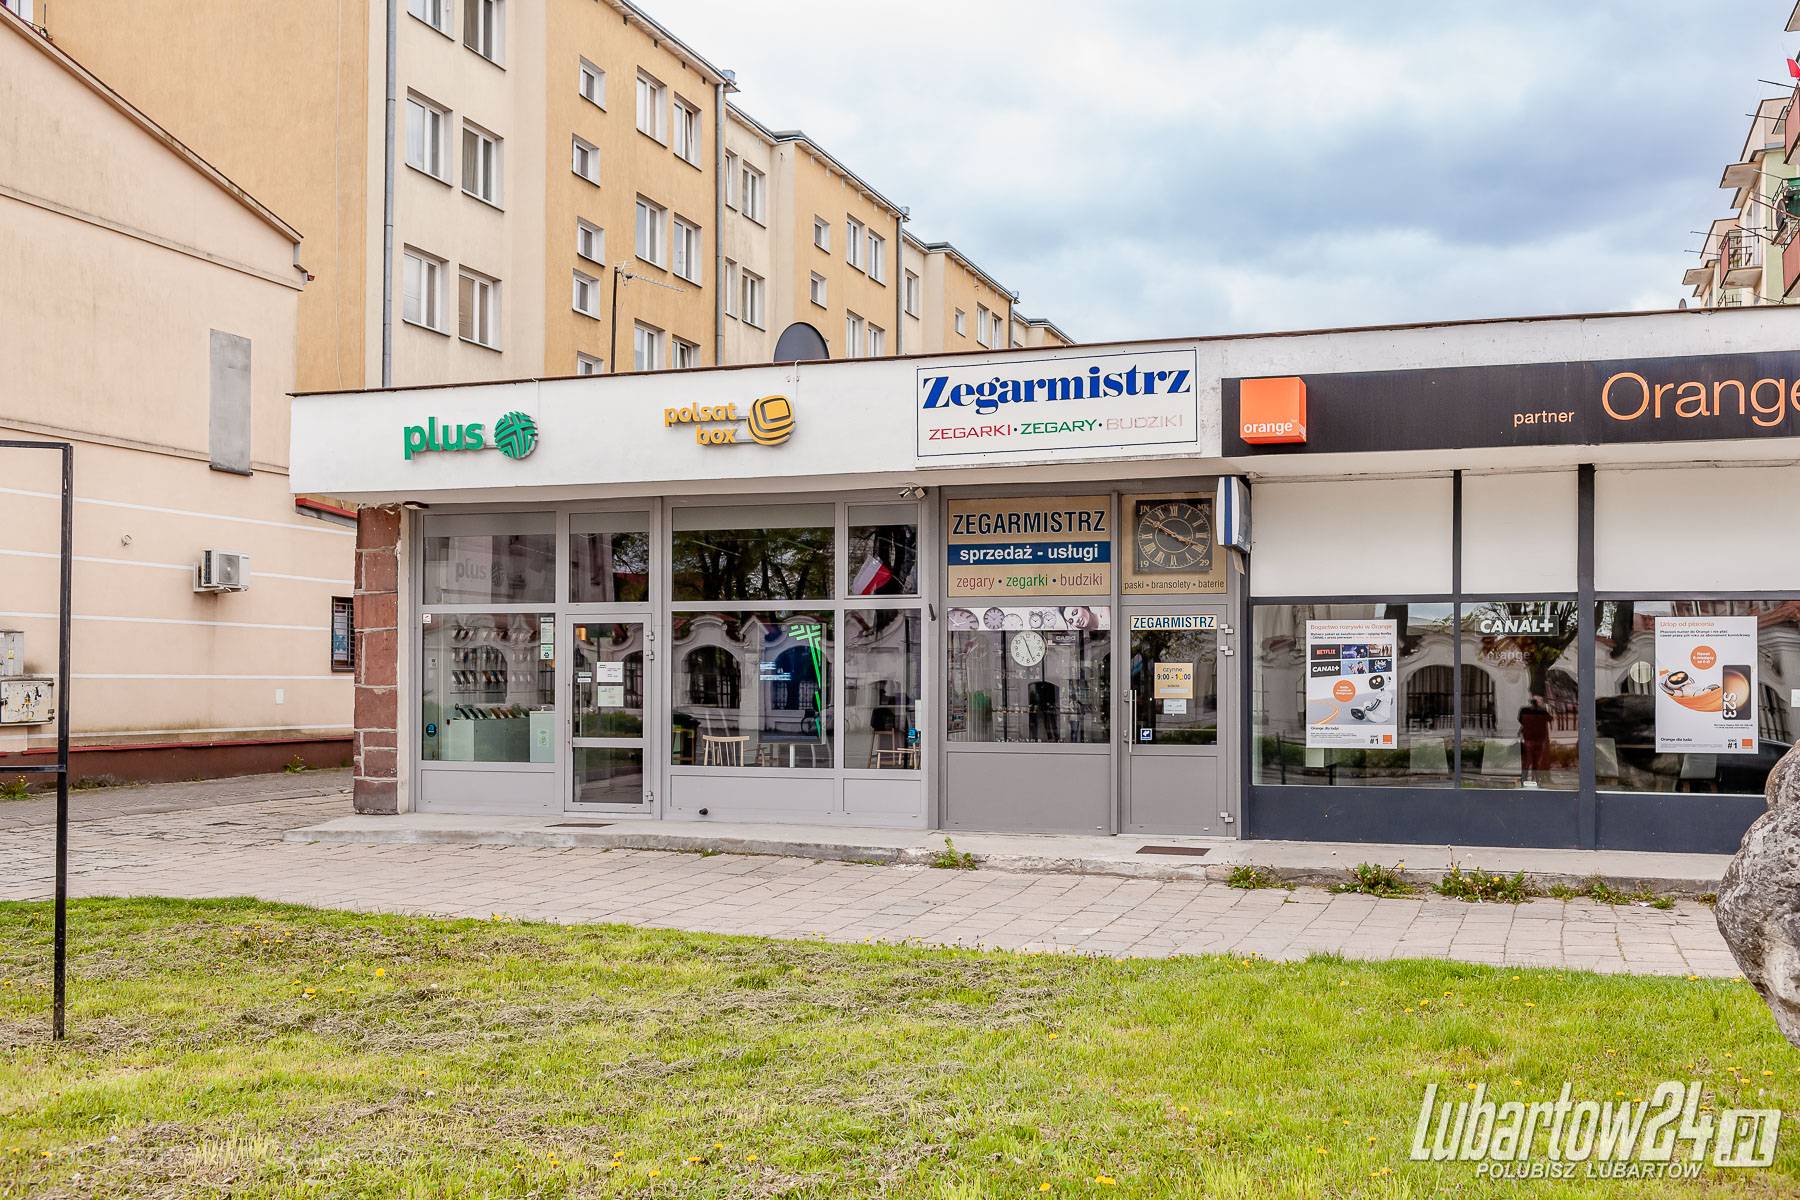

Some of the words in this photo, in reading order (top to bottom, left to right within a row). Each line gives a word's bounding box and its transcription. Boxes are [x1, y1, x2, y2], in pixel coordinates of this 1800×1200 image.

[922, 364, 1191, 415] Zegarmistrz
[1601, 372, 1800, 427] Orang
[664, 402, 737, 427] polsat
[1513, 409, 1575, 426] partner
[696, 424, 737, 446] box
[929, 423, 1011, 440] ZEGARKI
[1021, 418, 1098, 435] ZEGARY
[1106, 414, 1184, 431] BUDZIKI
[1243, 421, 1293, 436] orange
[403, 416, 485, 460] plus
[952, 510, 1106, 535] ZEGARMISTRZ
[960, 545, 1033, 564] sprzedaż
[1048, 543, 1098, 563] usługi
[956, 575, 995, 591] zegary
[1006, 573, 1048, 591] zegarki
[1060, 572, 1103, 587] budziki
[1124, 580, 1144, 590] paski
[1151, 579, 1191, 590] bransolety
[1198, 579, 1225, 588] baterie
[1133, 616, 1214, 629] ZEGARMISTRZ
[1480, 618, 1554, 634] CANAL+
[1312, 665, 1340, 673] CANAL+
[1723, 692, 1737, 719] S23
